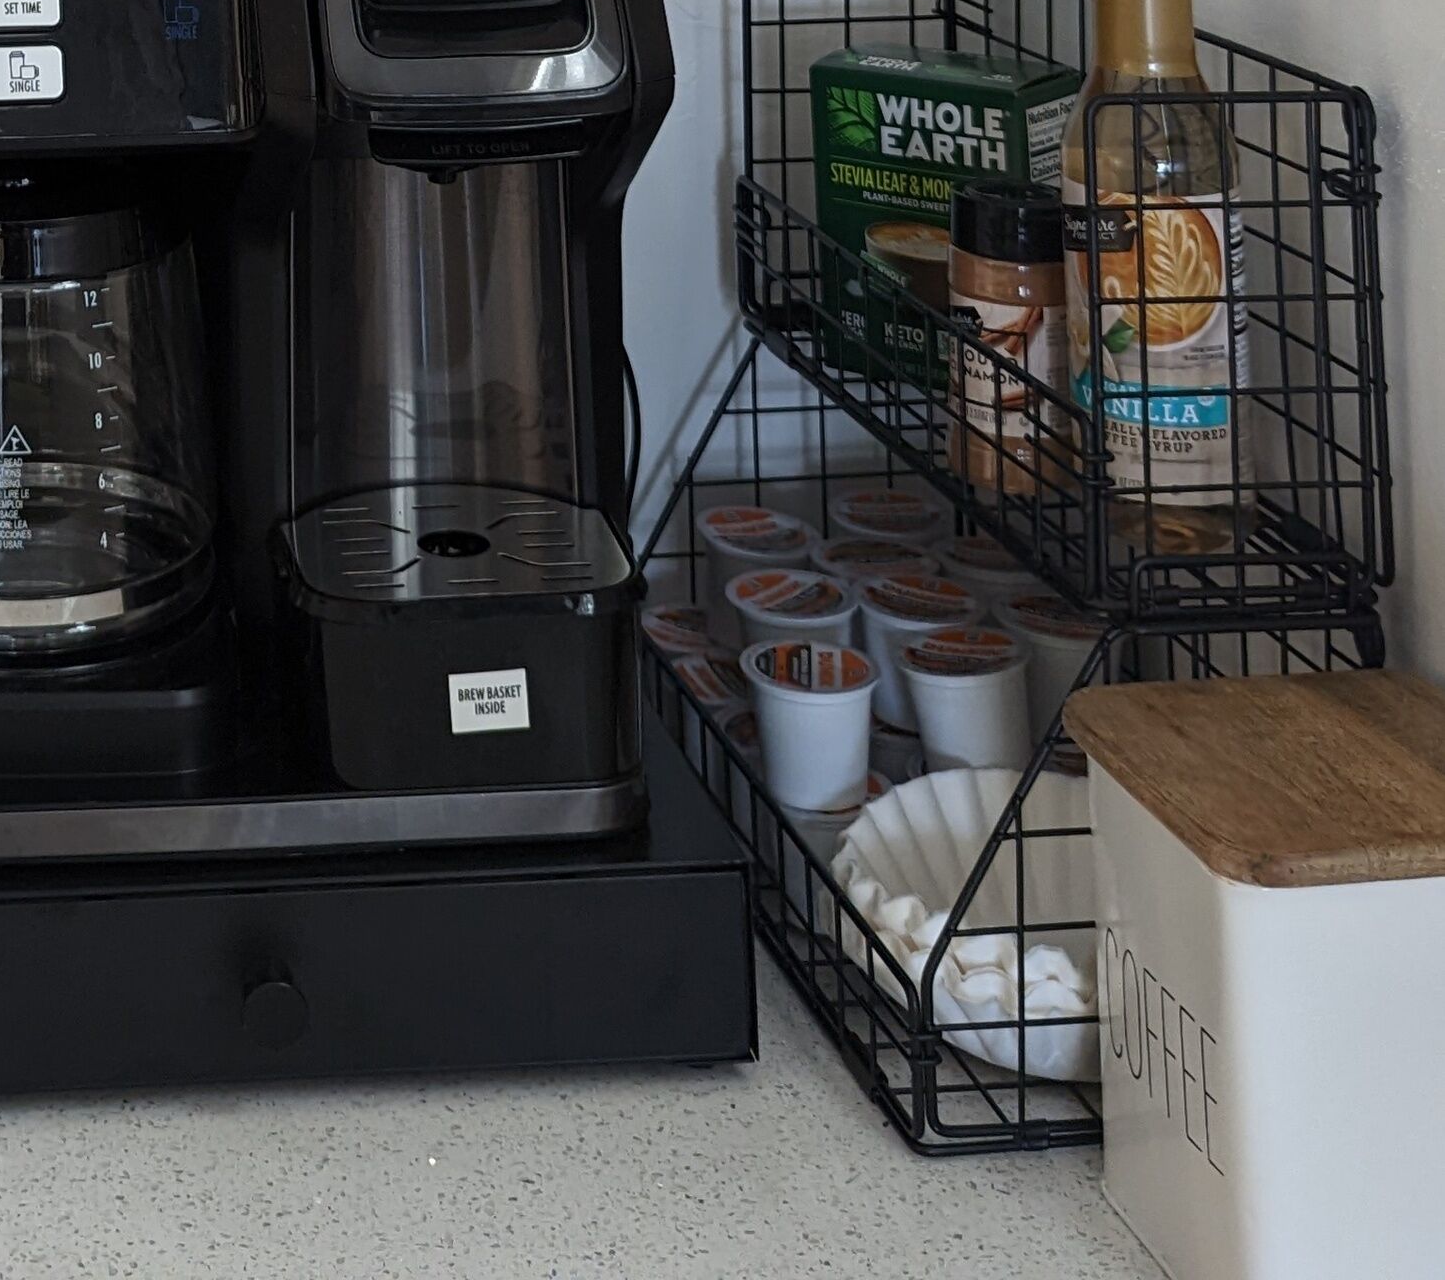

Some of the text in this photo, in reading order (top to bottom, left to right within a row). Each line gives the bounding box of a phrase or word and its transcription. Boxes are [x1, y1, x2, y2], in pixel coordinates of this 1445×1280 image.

[4, 1, 42, 15] SET TIME
[165, 24, 199, 40] SINGLE
[9, 79, 41, 93] SINGLE
[876, 92, 1005, 139] WHOLE
[880, 125, 1007, 171] EARTH
[830, 162, 952, 200] STEVIA LEAF & MON
[862, 190, 951, 213] PLANT-BASED SWEET
[83, 290, 98, 307] 12
[88, 351, 102, 369] 10
[94, 412, 103, 430] 8
[1152, 428, 1227, 441] FLAVORED
[1150, 440, 1193, 453] YRUP
[98, 473, 106, 490] 6
[14, 519, 29, 529] LEA
[99, 531, 108, 550] 4
[457, 684, 522, 702] BREW BASKET
[474, 700, 506, 715] INSIDE
[1105, 927, 1225, 1176] COFFEE
